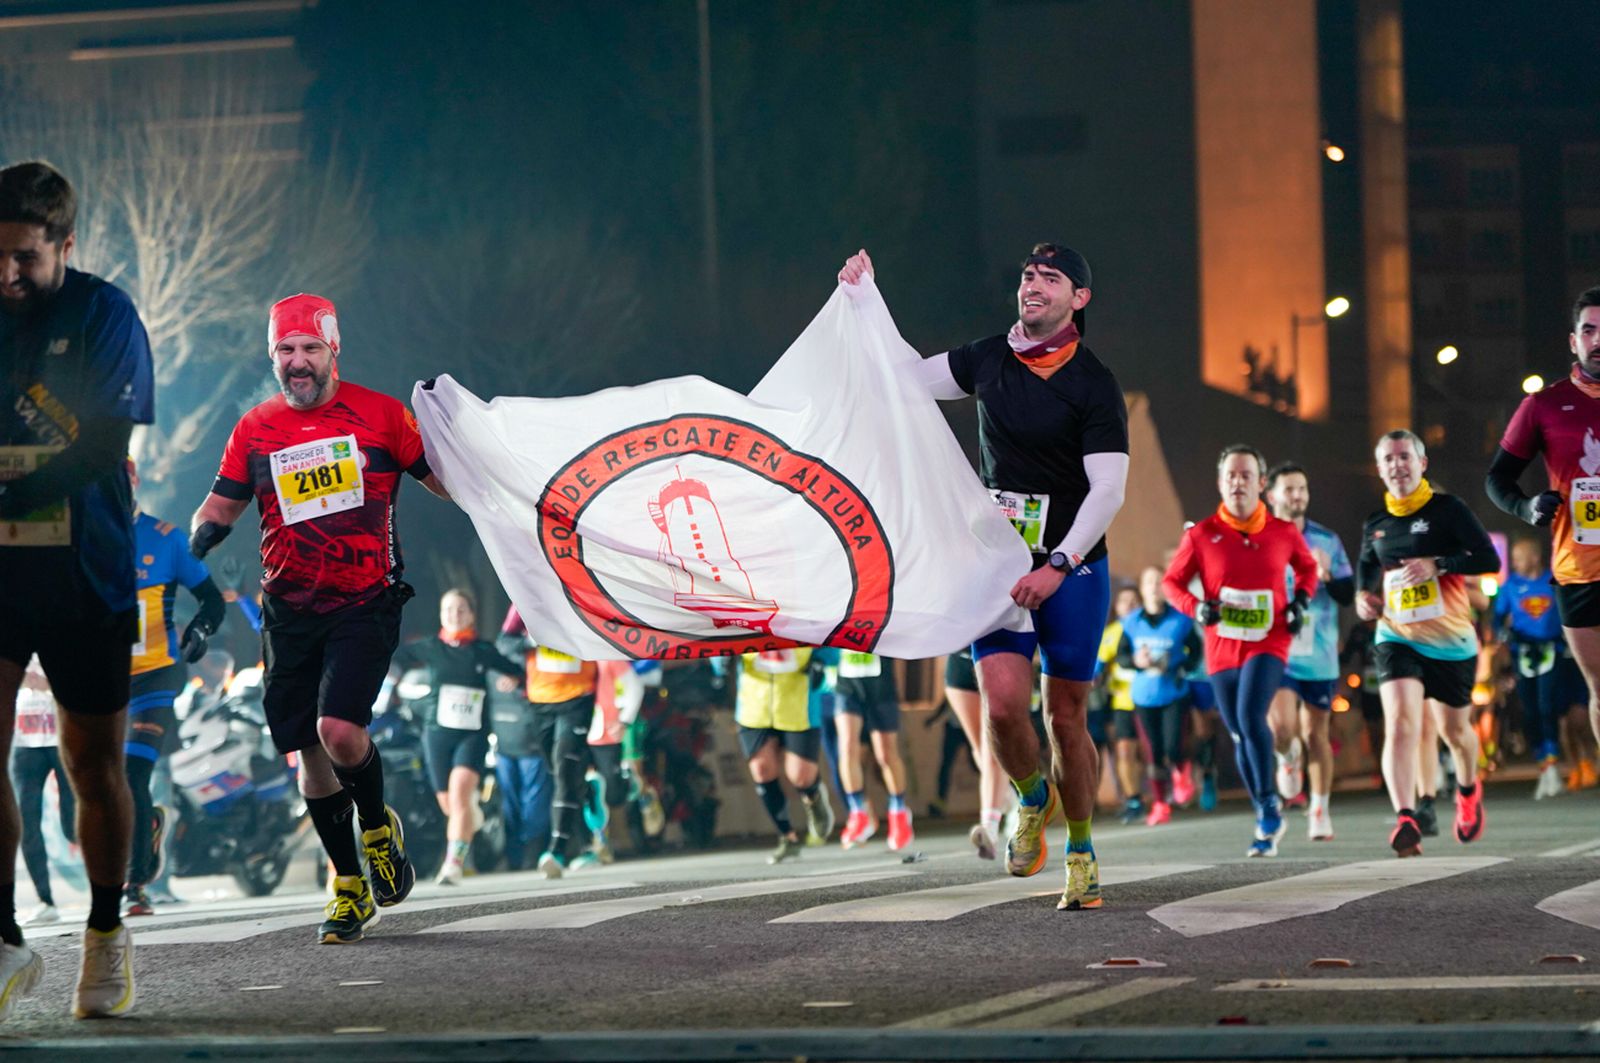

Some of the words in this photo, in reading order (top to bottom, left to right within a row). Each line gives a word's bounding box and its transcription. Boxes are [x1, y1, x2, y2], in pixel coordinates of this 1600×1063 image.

[290, 450, 314, 461] NOCHE
[315, 447, 324, 456] DE
[282, 464, 298, 474] SAN
[294, 462, 343, 495] 2181
[561, 468, 597, 502] DE
[602, 426, 739, 471] RESCATE
[747, 441, 782, 472] EN
[790, 467, 873, 550] ALTURA
[1228, 608, 1265, 624] 12257
